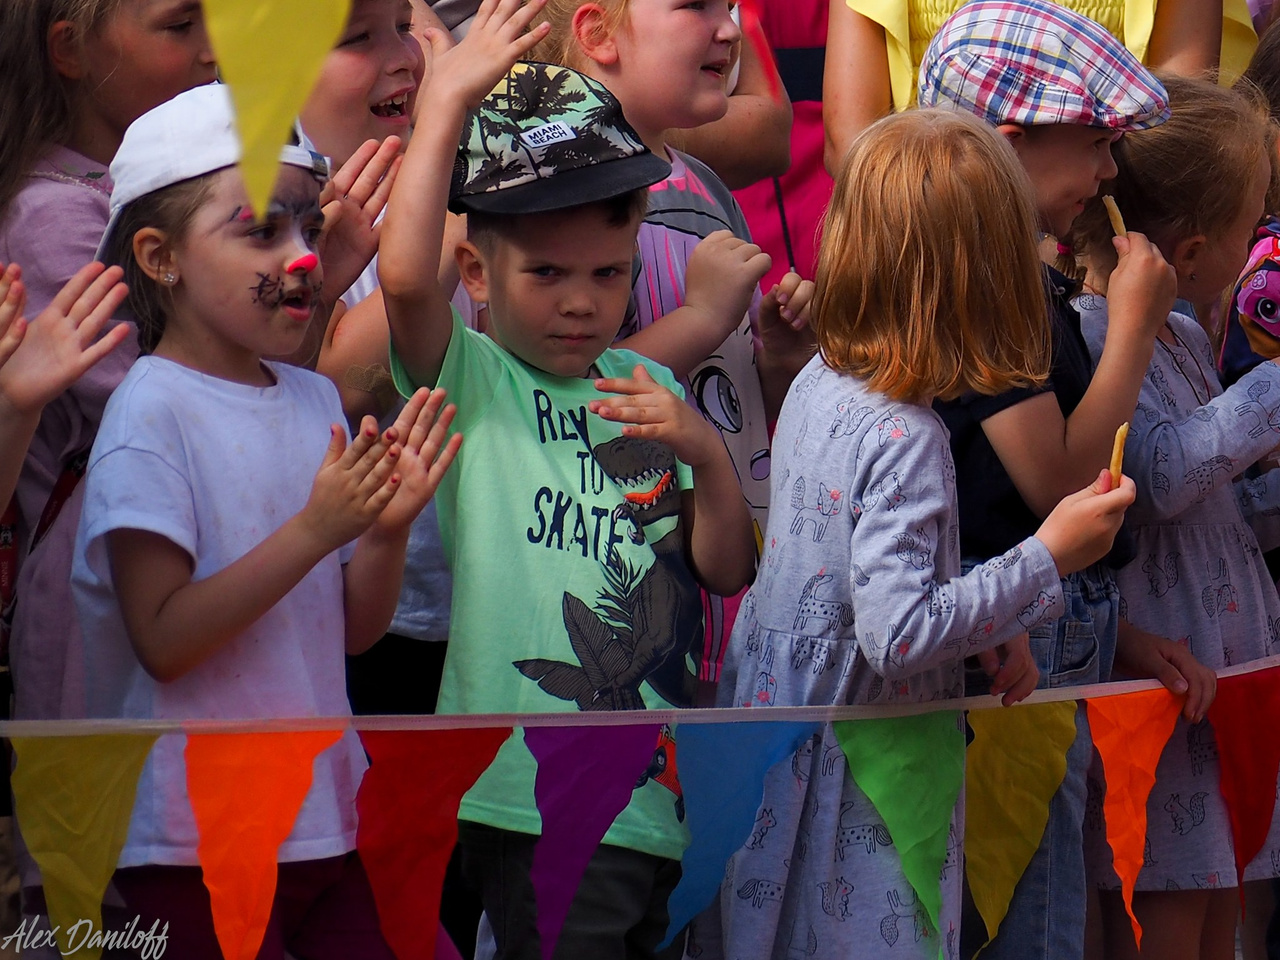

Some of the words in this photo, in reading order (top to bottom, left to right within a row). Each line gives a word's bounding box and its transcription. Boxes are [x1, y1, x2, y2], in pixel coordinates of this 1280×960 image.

[527, 123, 563, 141] MIAMI
[532, 129, 568, 145] BEACH
[527, 486, 629, 567] SKATE
